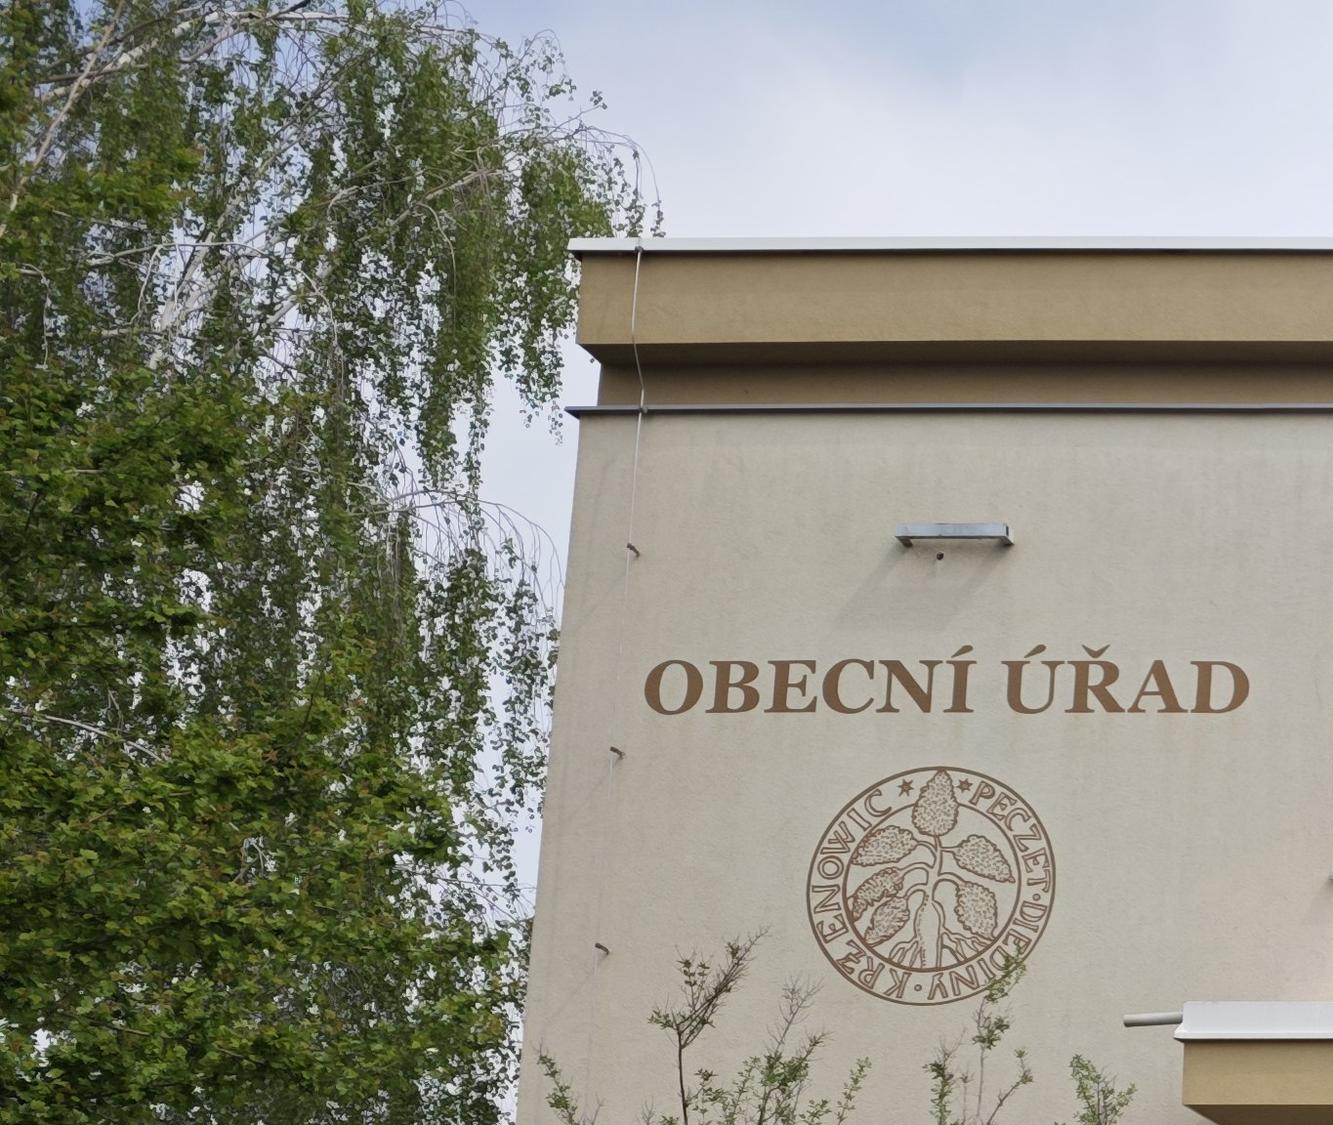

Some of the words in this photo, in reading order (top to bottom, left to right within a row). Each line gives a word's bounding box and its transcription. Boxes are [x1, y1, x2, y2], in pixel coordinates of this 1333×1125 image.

[644, 644, 977, 716] OBECNÍ
[1001, 644, 1251, 716] ÚŘAD
[969, 781, 1050, 894] PECZET
